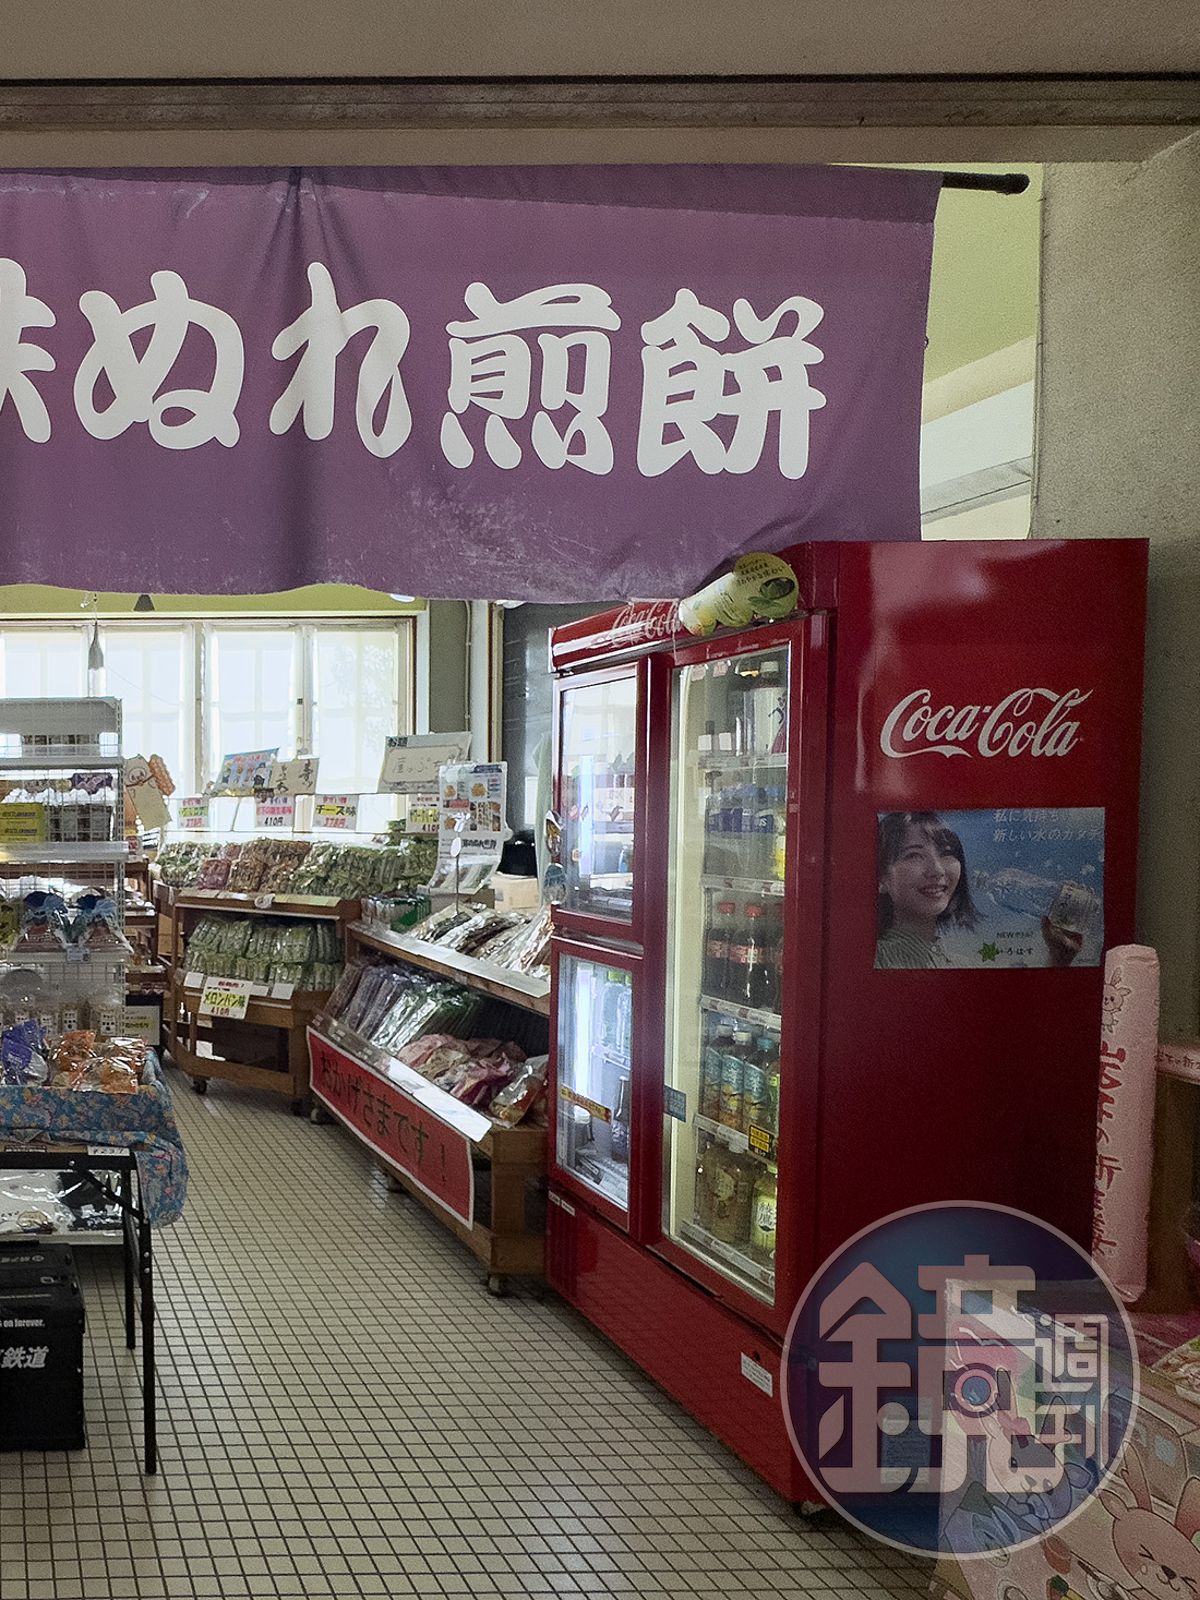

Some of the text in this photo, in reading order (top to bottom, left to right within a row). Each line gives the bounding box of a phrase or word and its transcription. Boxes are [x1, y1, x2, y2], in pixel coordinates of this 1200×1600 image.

[880, 688, 1093, 758] Coca-Cola
[265, 816, 283, 827] 410円
[0, 1346, 49, 1369] 鉄道
